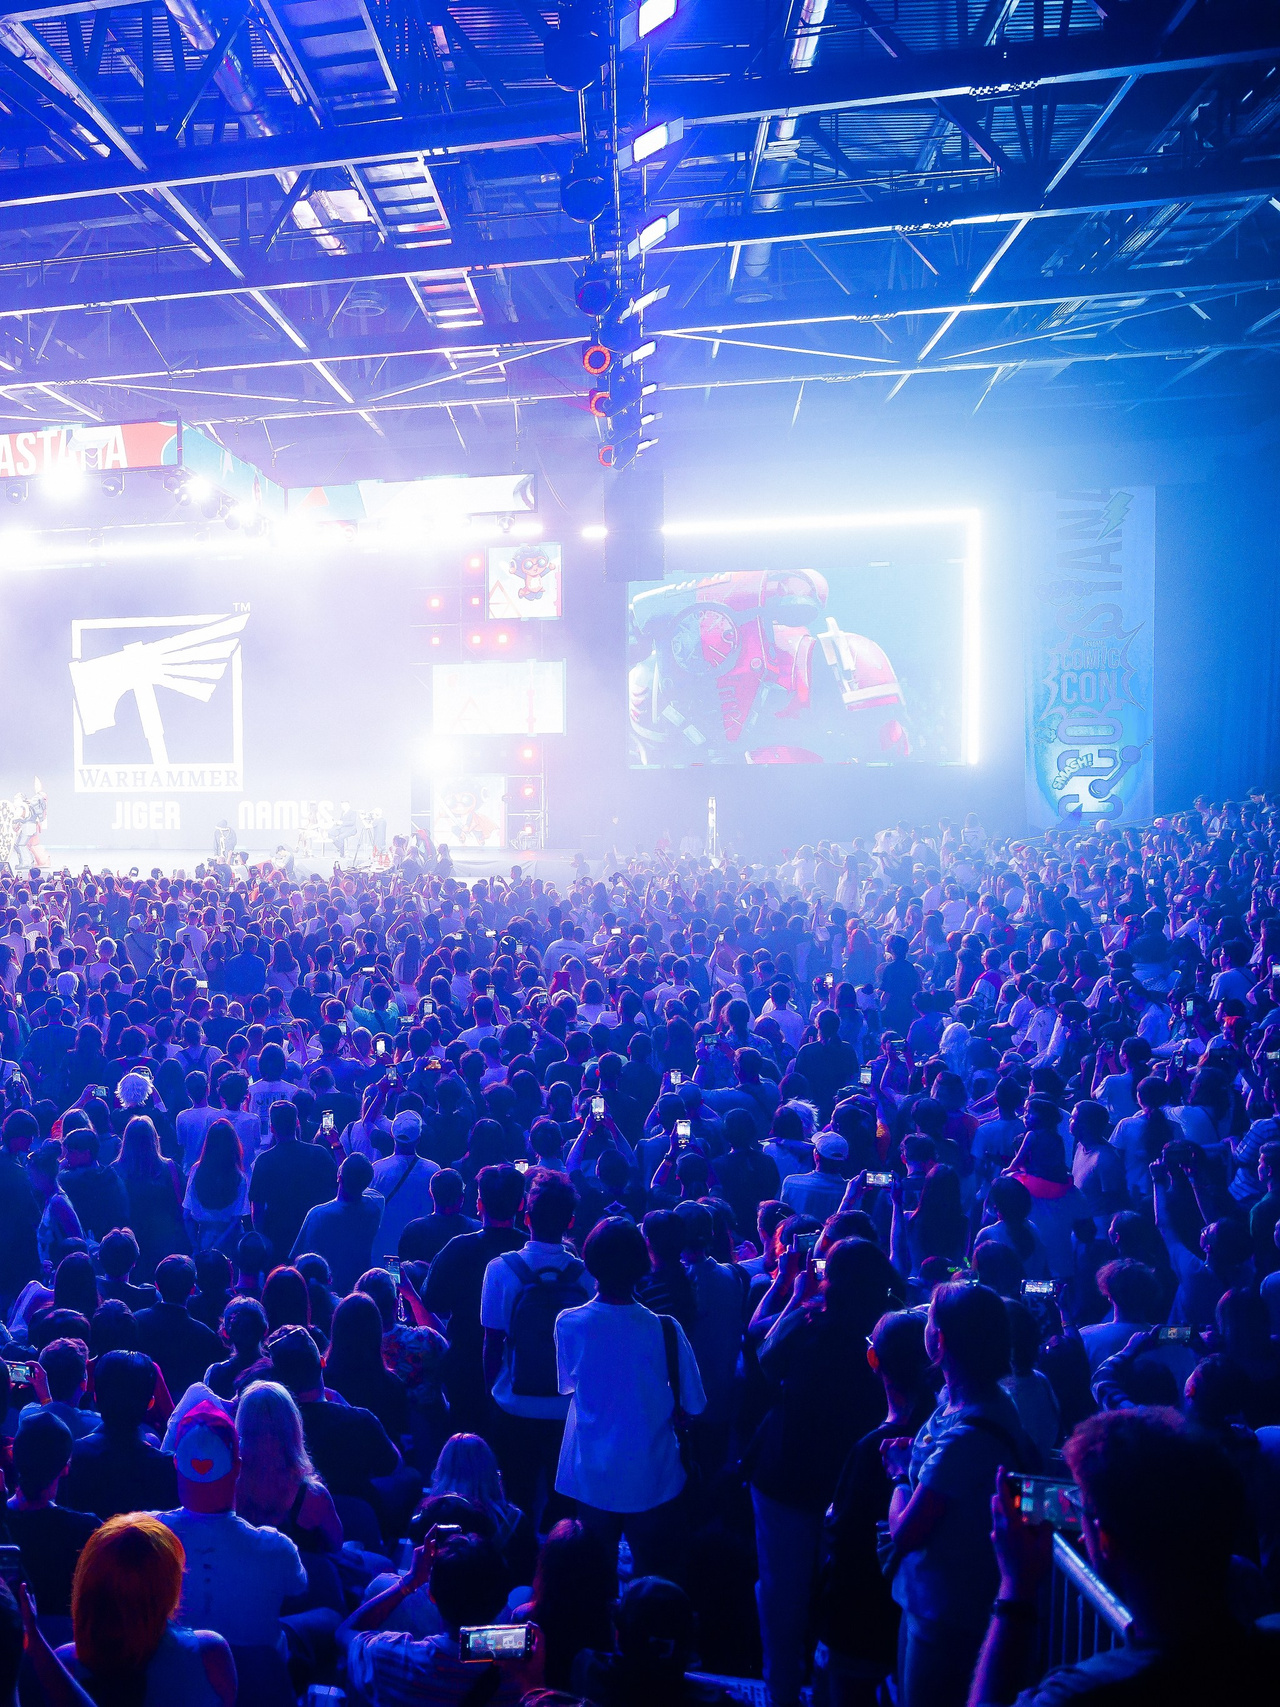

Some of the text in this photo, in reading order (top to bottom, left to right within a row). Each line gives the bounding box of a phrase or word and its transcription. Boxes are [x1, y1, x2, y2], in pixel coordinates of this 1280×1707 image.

[232, 601, 251, 613] TM
[1060, 670, 1118, 705] CON
[1052, 752, 1094, 791] SMASH!
[111, 801, 181, 830] JIGER
